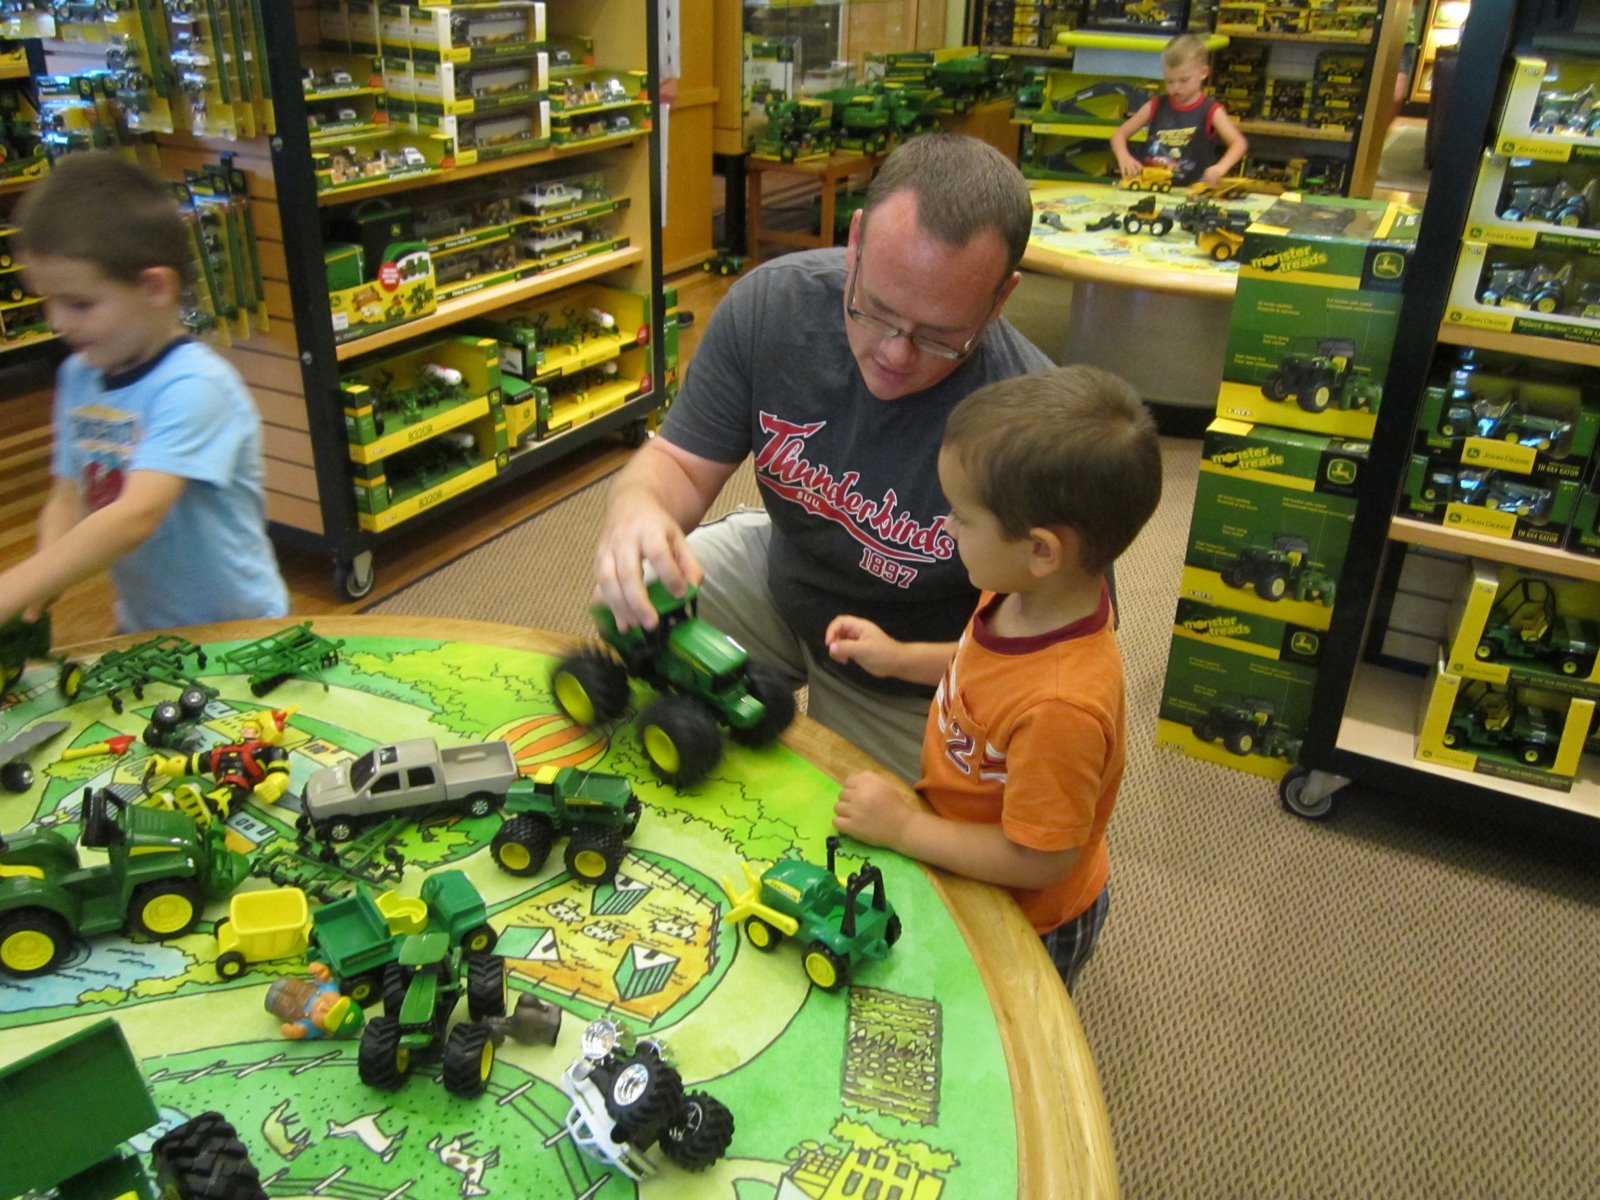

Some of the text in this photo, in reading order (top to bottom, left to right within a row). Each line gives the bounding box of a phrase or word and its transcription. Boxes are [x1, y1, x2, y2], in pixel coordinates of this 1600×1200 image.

[1280, 252, 1328, 273] treads
[408, 424, 433, 442] 8320R
[1239, 453, 1285, 470] treads
[755, 410, 954, 559] Thunderbirds
[859, 547, 918, 588] 1897
[1209, 624, 1250, 637] treads
